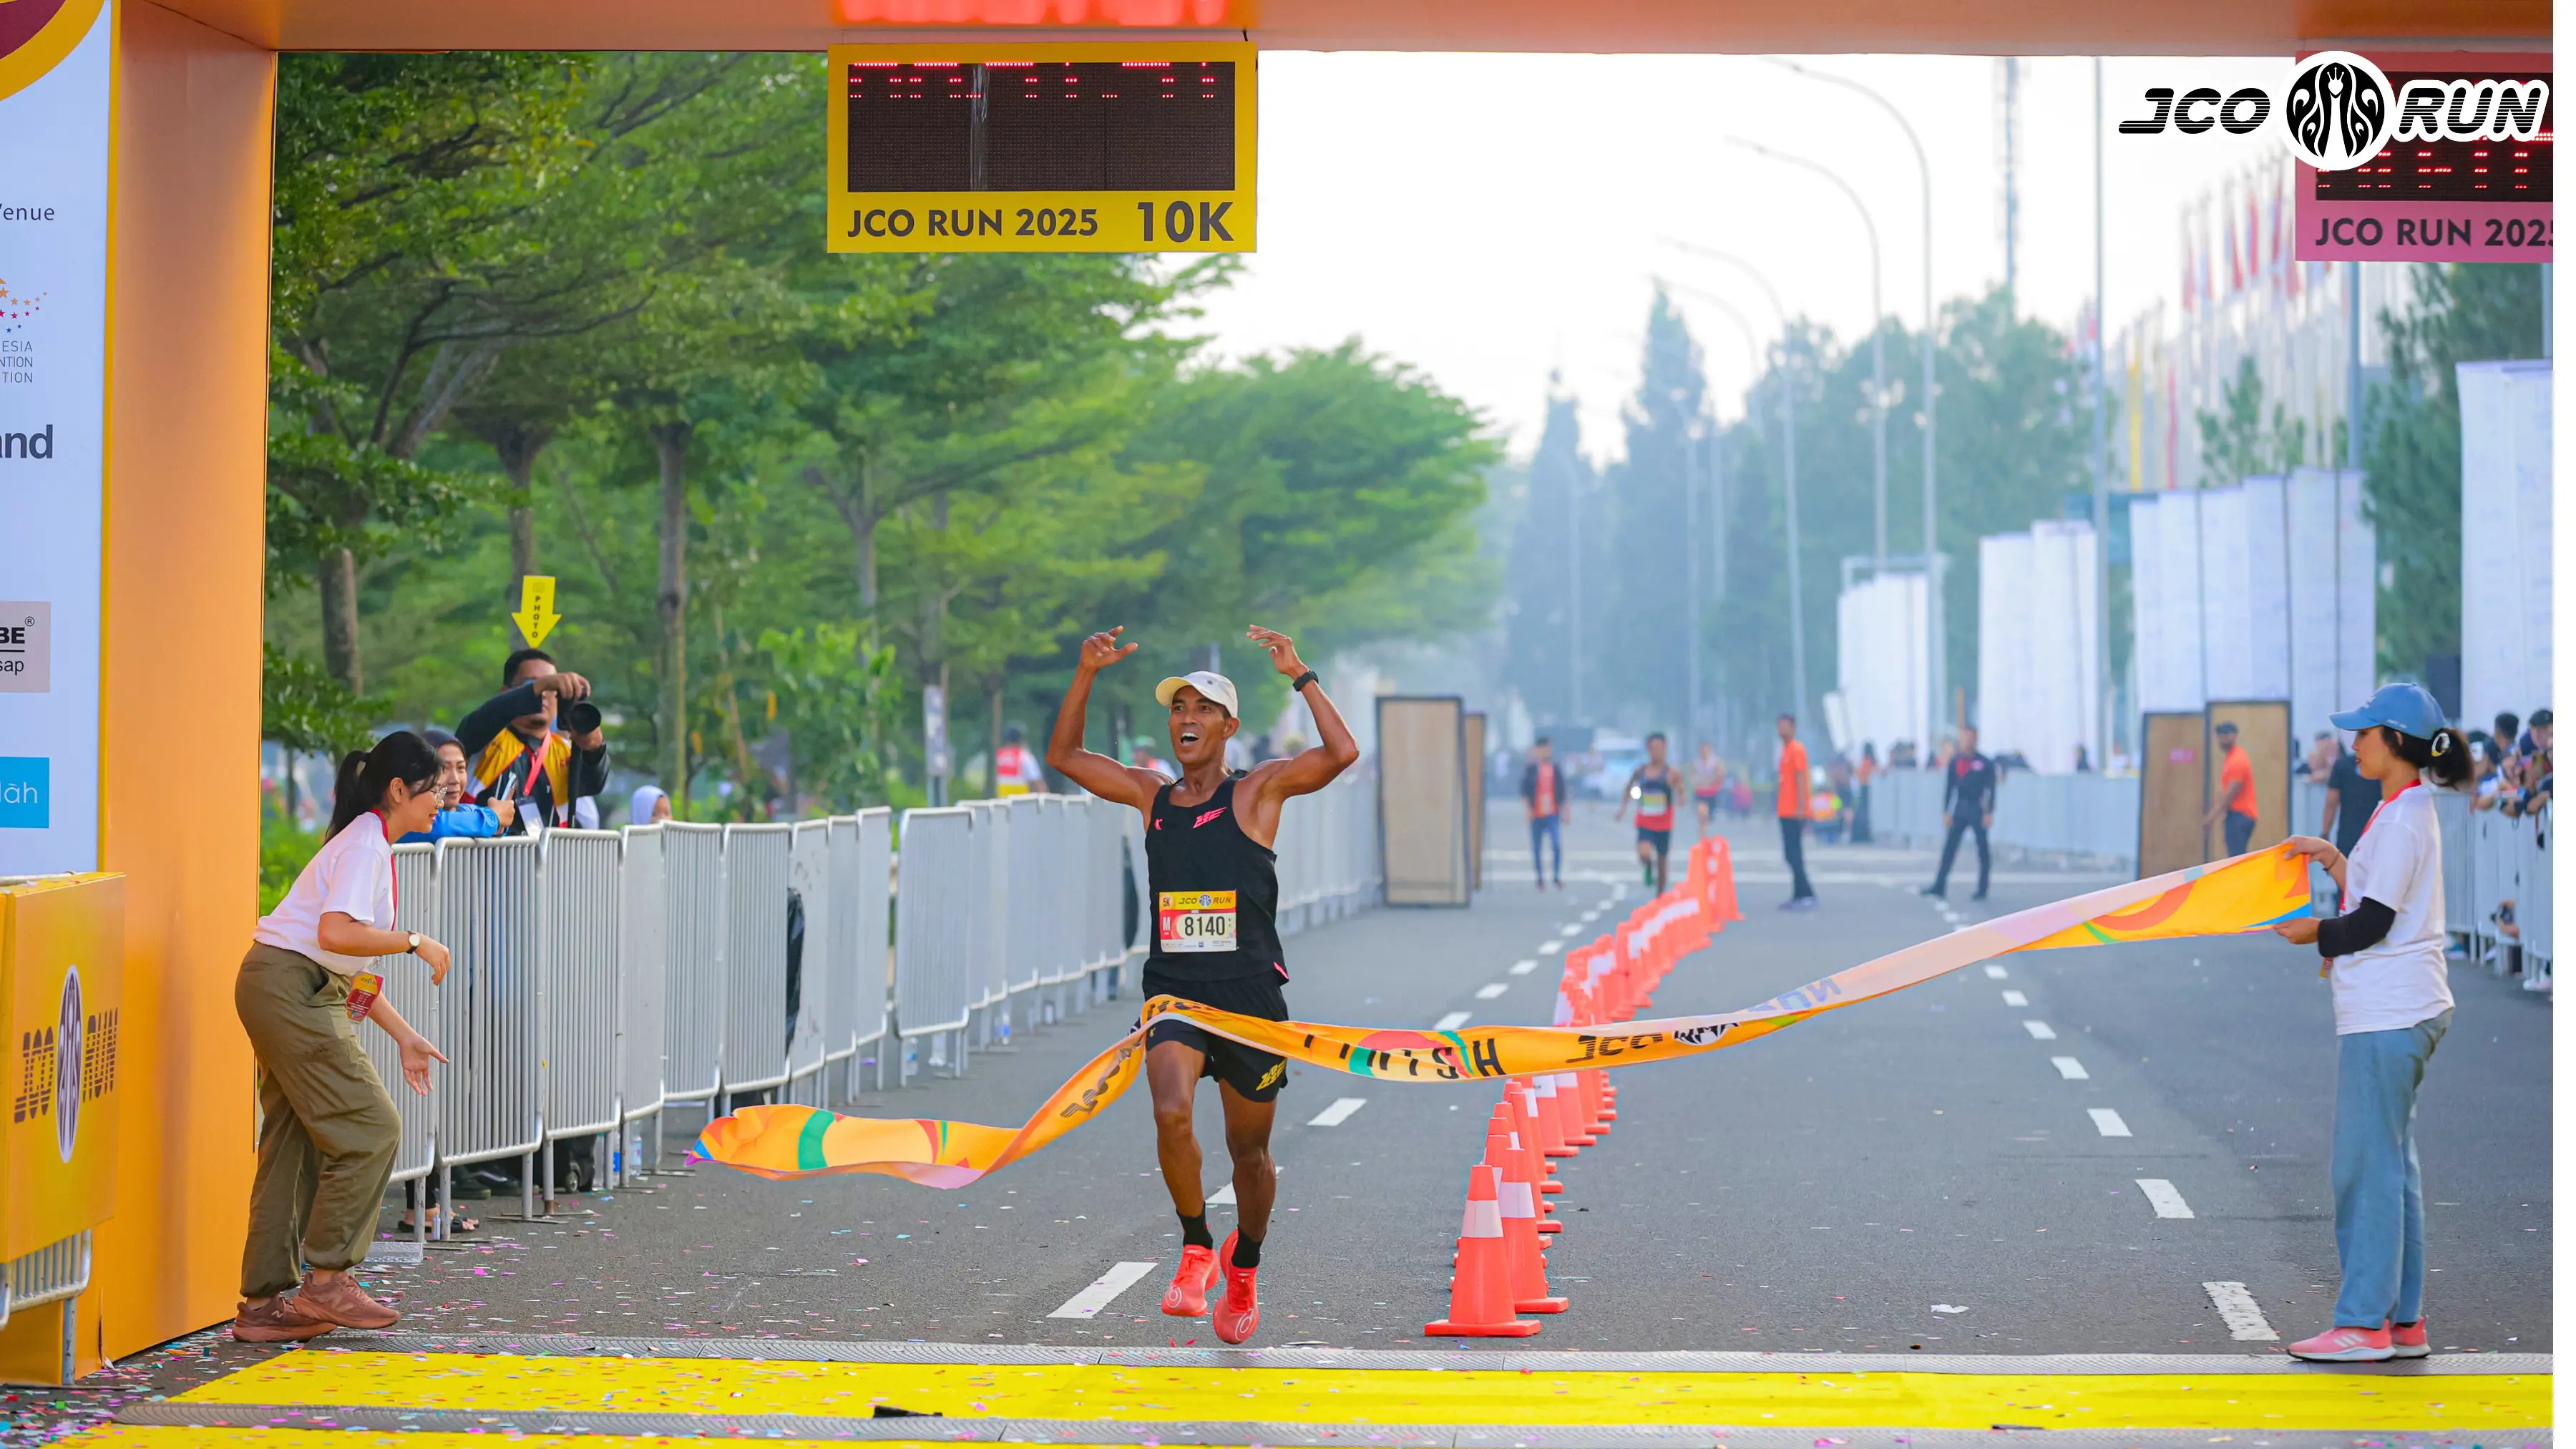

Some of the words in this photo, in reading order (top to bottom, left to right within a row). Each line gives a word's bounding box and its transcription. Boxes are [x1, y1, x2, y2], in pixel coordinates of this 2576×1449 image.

[0, 203, 54, 220] enue
[847, 209, 914, 238] JCO
[928, 209, 1002, 237] RUN
[1015, 208, 1098, 237] 2025
[1136, 200, 1234, 243] 10K
[2316, 218, 2383, 246] JCO
[2397, 218, 2472, 246] RUN
[2484, 218, 2553, 247] 202
[2, 341, 33, 352] ESIA
[2, 372, 33, 383] TION
[0, 424, 53, 459] nd
[532, 595, 541, 638] PHOTO
[0, 781, 37, 804] àh
[1162, 897, 1171, 907] 5K
[1163, 917, 1171, 931] M
[1184, 916, 1225, 937] 8140
[14, 1026, 54, 1124] JCO
[83, 1006, 118, 1103] RUN
